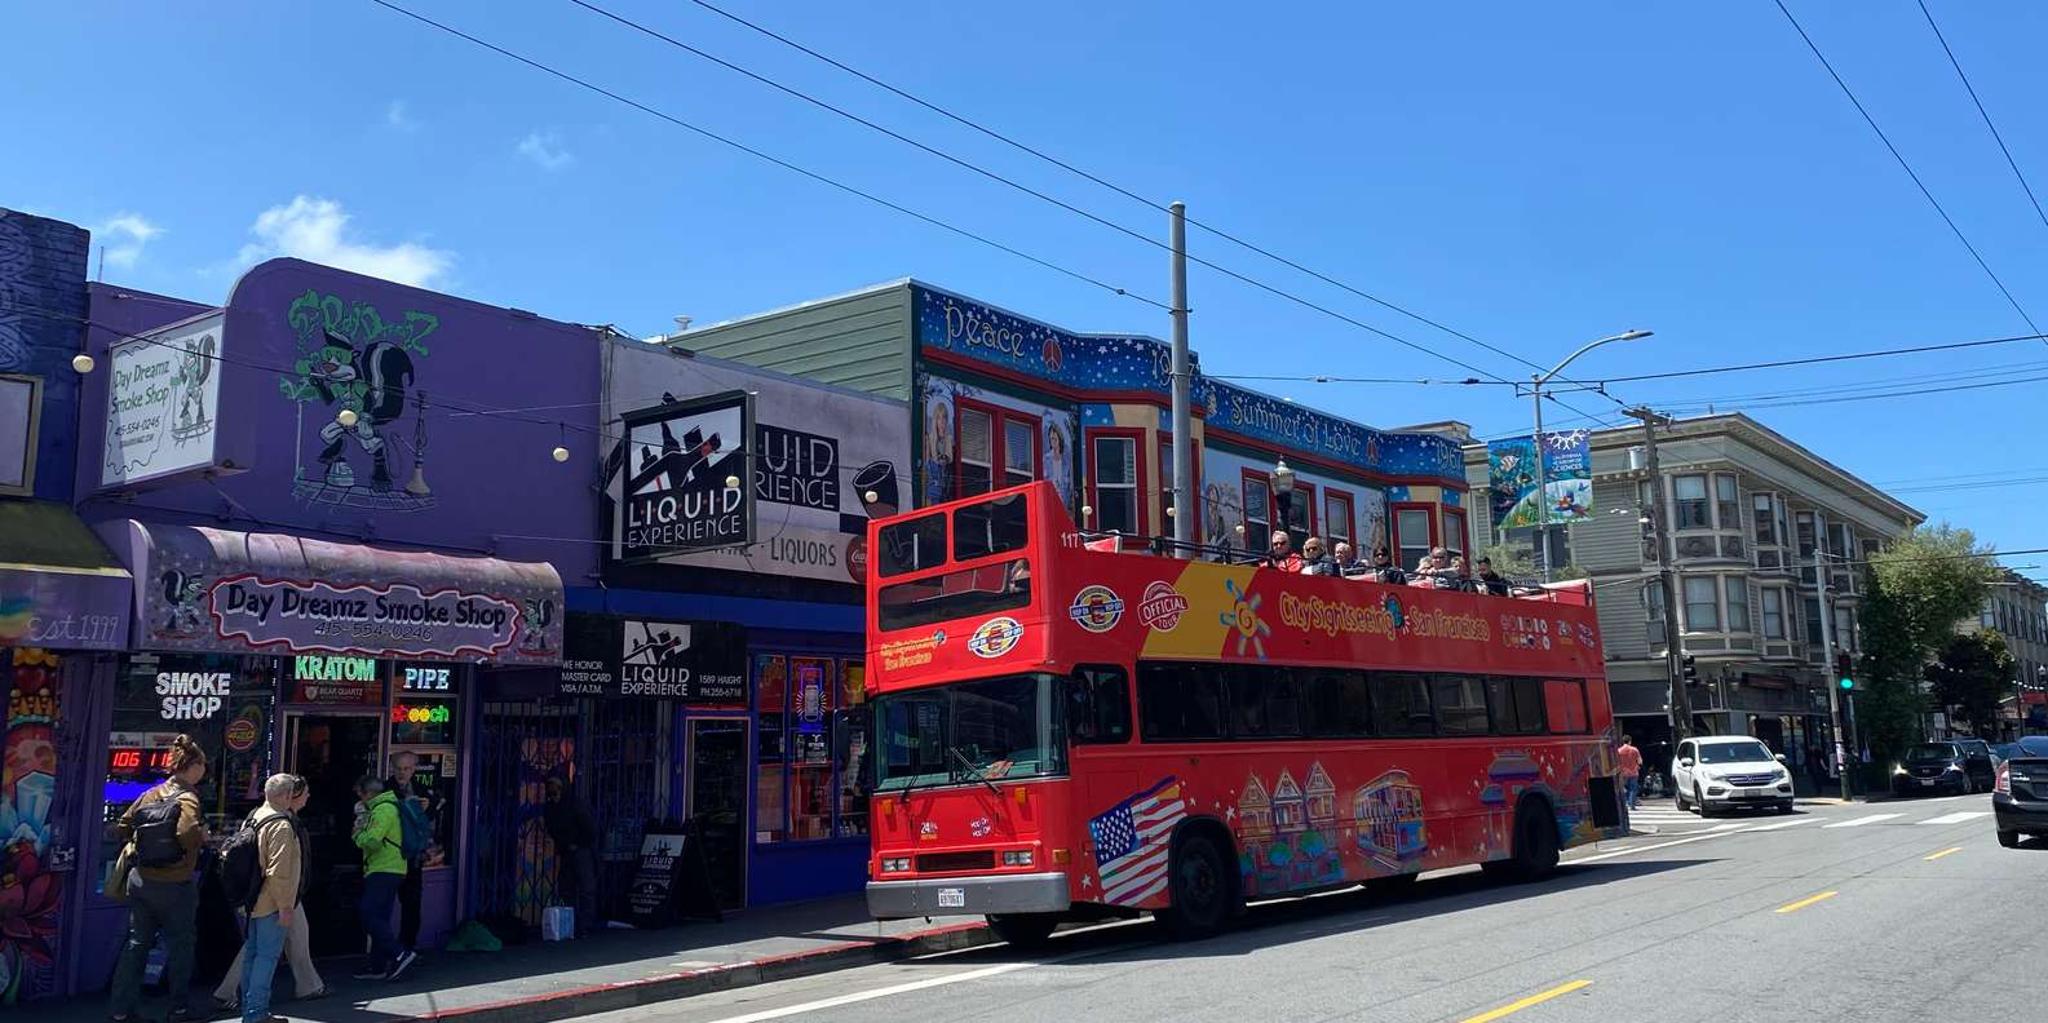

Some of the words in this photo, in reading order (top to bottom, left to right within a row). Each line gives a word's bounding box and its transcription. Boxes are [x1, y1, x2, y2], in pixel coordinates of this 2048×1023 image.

[943, 303, 1025, 358] Peace
[115, 371, 131, 391] Day
[134, 361, 169, 383] Dreamz
[1152, 350, 1194, 387] 197
[112, 392, 142, 414] Smoke
[146, 384, 169, 406] Shop
[1231, 394, 1299, 438] Summer
[1304, 419, 1319, 449] of
[1325, 424, 1360, 456] Love
[764, 431, 834, 477] UID
[1437, 441, 1462, 469] 1967
[755, 470, 836, 508] RIENCE
[629, 487, 742, 528] LIQUID
[628, 514, 740, 549] EXPERIENCE
[1061, 532, 1078, 548] 117
[771, 537, 837, 567] LIQUORS
[226, 584, 274, 627] Day
[280, 588, 369, 622] Dreamz
[374, 595, 449, 625] Smoke
[454, 600, 507, 637] Shop
[1143, 598, 1187, 621] OFFICIAL
[1159, 615, 1178, 629] TOUR
[315, 621, 433, 641] 415-554-0246
[294, 655, 375, 682] KRATOM
[403, 668, 450, 690] PIPE
[561, 672, 590, 682] MASTER
[590, 672, 612, 683] CARD
[562, 660, 574, 670] WE
[575, 660, 603, 671] HONOR
[621, 665, 690, 683] LIQUID
[155, 672, 231, 696] SMOKE
[621, 682, 688, 696] EXPERIENCE
[160, 697, 222, 720] SHOP
[113, 752, 140, 767] 106
